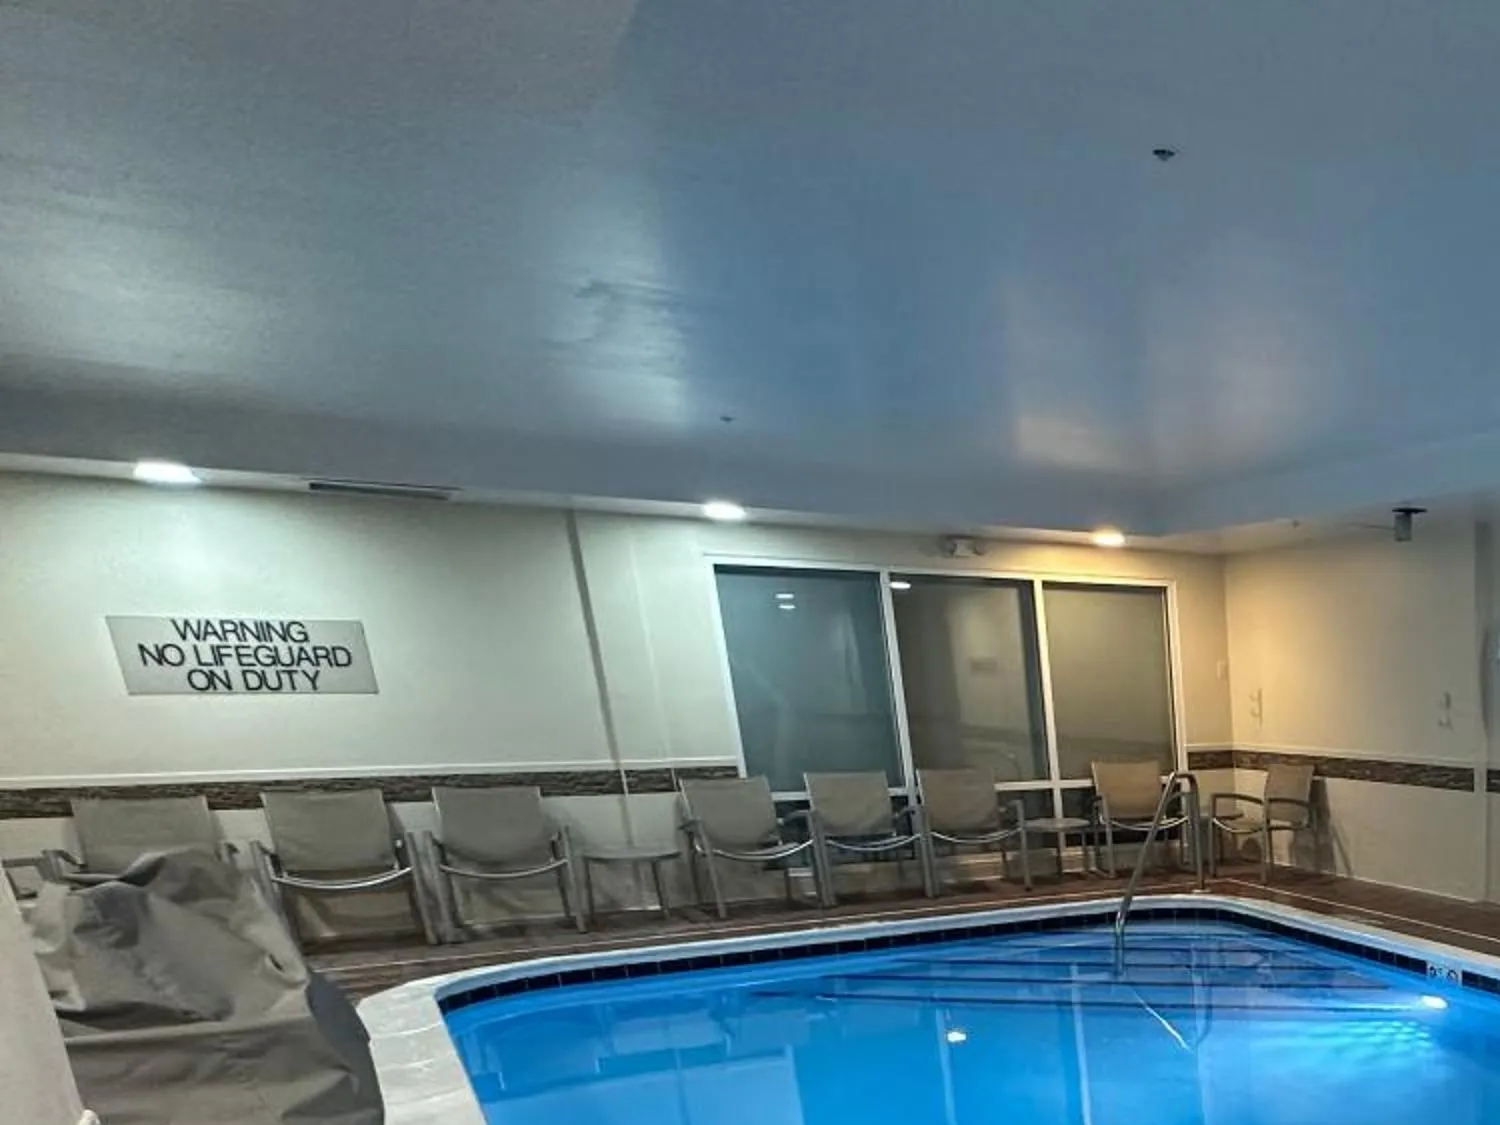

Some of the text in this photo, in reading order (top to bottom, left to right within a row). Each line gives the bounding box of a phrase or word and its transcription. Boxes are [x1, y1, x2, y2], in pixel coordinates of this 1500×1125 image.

[170, 618, 309, 643] WARNING
[137, 643, 352, 667] NO LIFEGUARD
[187, 668, 320, 691] ON DUTY
